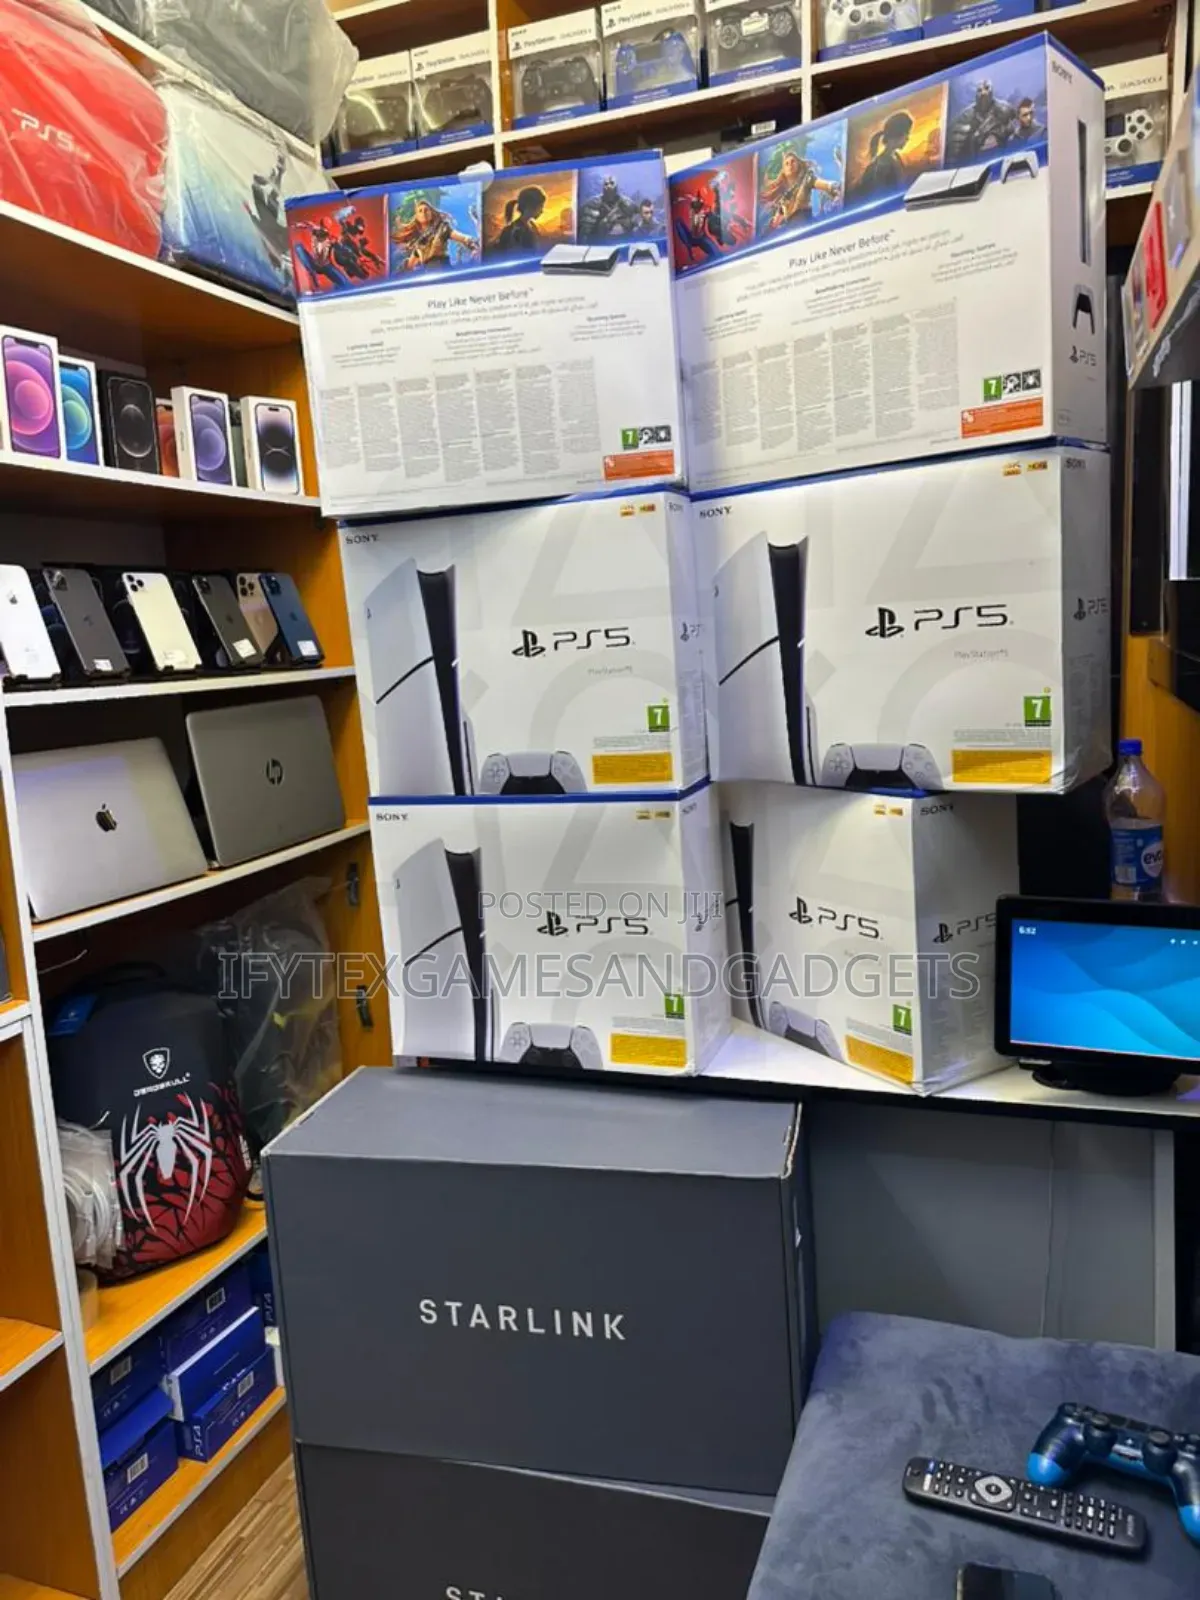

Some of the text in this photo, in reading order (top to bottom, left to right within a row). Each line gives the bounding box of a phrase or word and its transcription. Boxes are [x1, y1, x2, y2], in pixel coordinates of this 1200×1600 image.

[11, 107, 74, 153] PS5
[788, 257, 808, 269] Play
[810, 249, 828, 263] Like
[829, 242, 857, 257] Never
[427, 297, 447, 309] Play
[449, 296, 468, 306] Like
[469, 291, 496, 304] Never
[987, 379, 998, 396] 7
[699, 505, 732, 518] SONY
[345, 534, 379, 545] SONY
[914, 604, 1009, 632] PS5
[552, 626, 631, 651] PS5
[653, 707, 663, 726] 7
[1031, 699, 1043, 719] 7
[375, 813, 408, 822] SONY
[920, 803, 954, 815] SONY
[576, 915, 649, 936] PS5
[818, 906, 880, 939] PS5
[896, 1007, 908, 1027] 7
[419, 1299, 627, 1341] STARLINK
[193, 1425, 205, 1457] PS4
